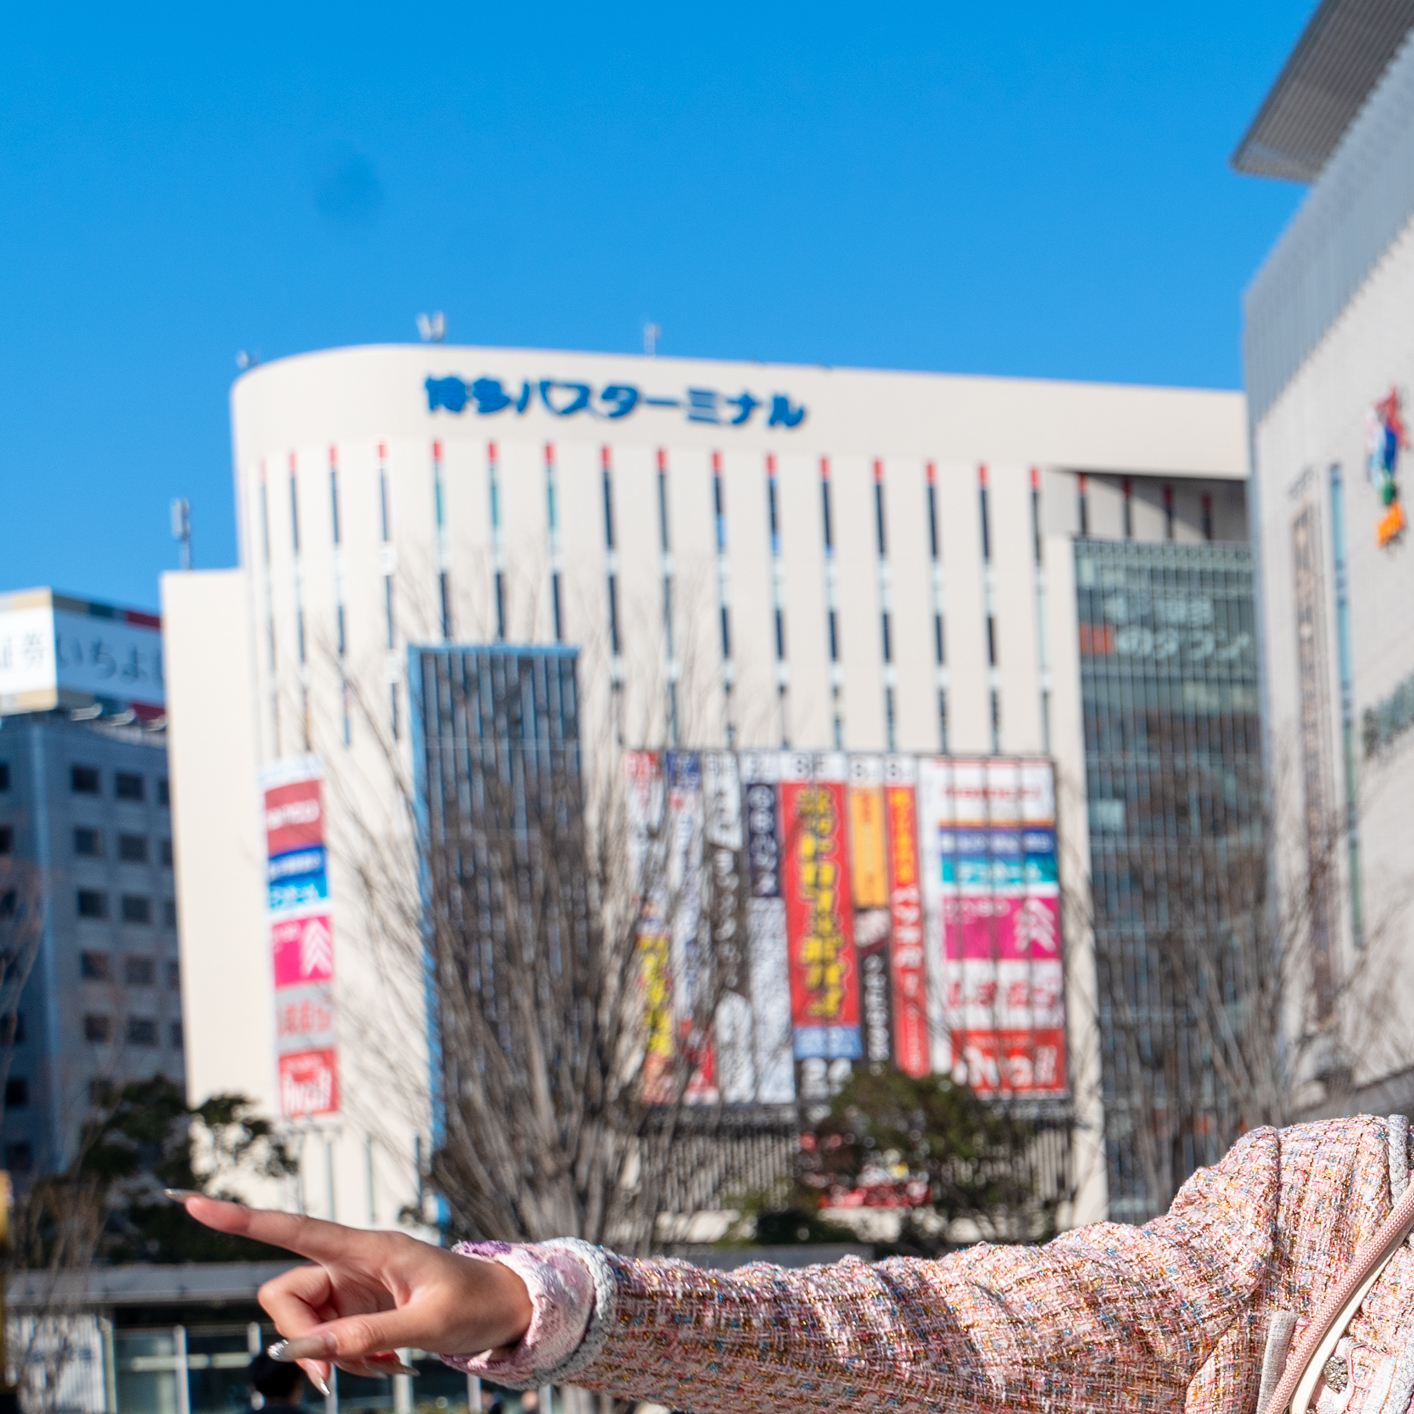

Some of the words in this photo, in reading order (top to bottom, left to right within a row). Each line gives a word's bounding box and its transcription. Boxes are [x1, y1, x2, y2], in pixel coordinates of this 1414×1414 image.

[425, 373, 806, 427] 博多バスターミナル
